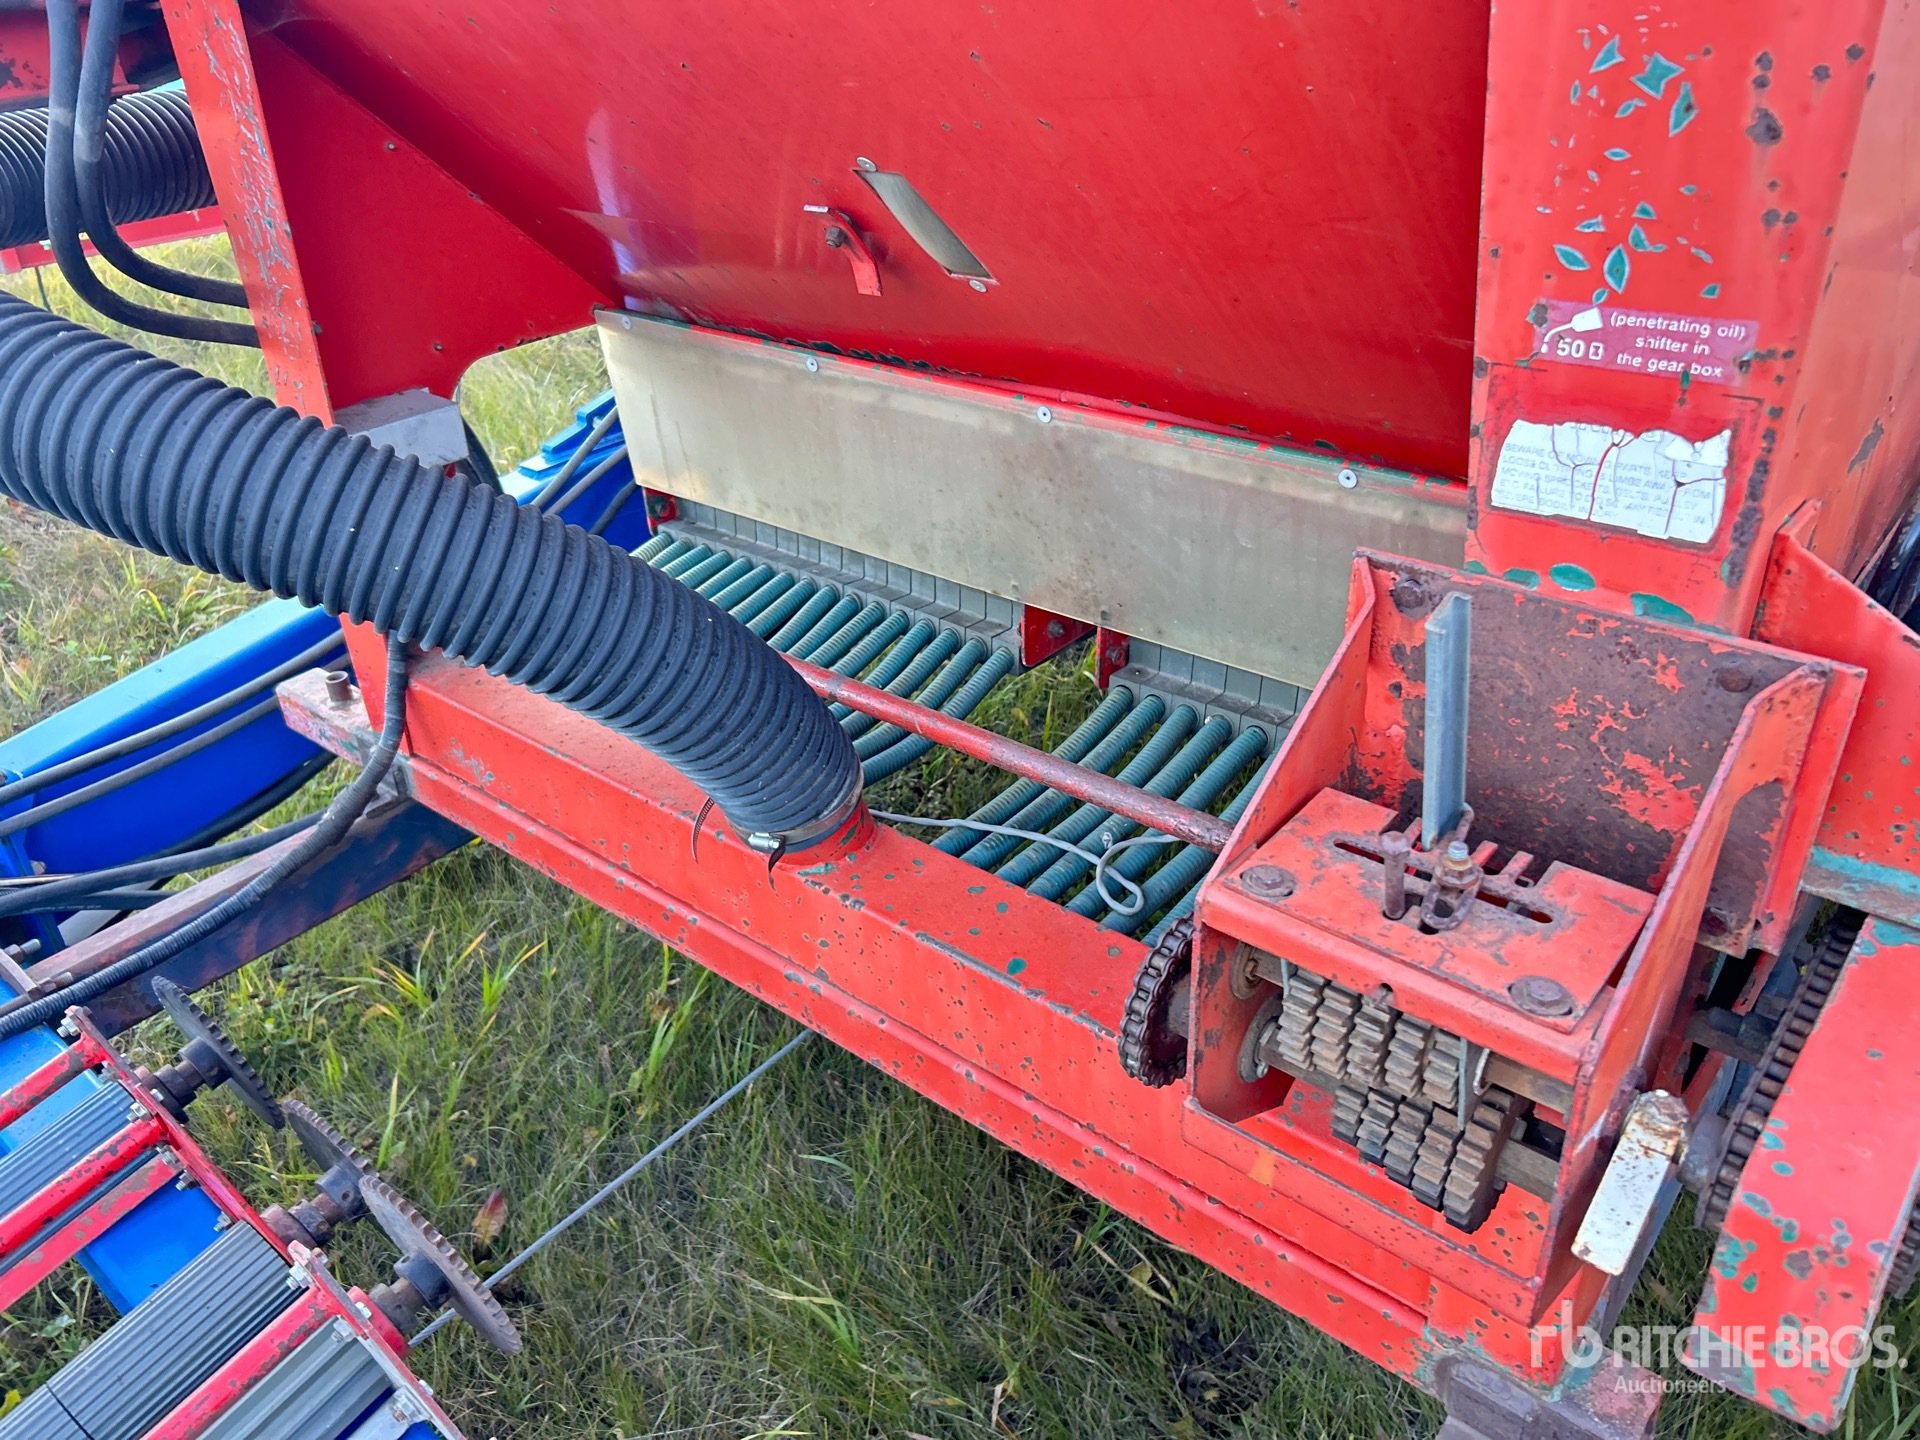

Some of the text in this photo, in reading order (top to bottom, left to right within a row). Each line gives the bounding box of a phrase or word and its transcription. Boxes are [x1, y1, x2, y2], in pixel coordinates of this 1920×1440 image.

[1610, 311, 1746, 341] (penetrating oil)
[1556, 338, 1584, 359] 50
[1693, 341, 1710, 355] in
[1617, 353, 1723, 377] the gear box
